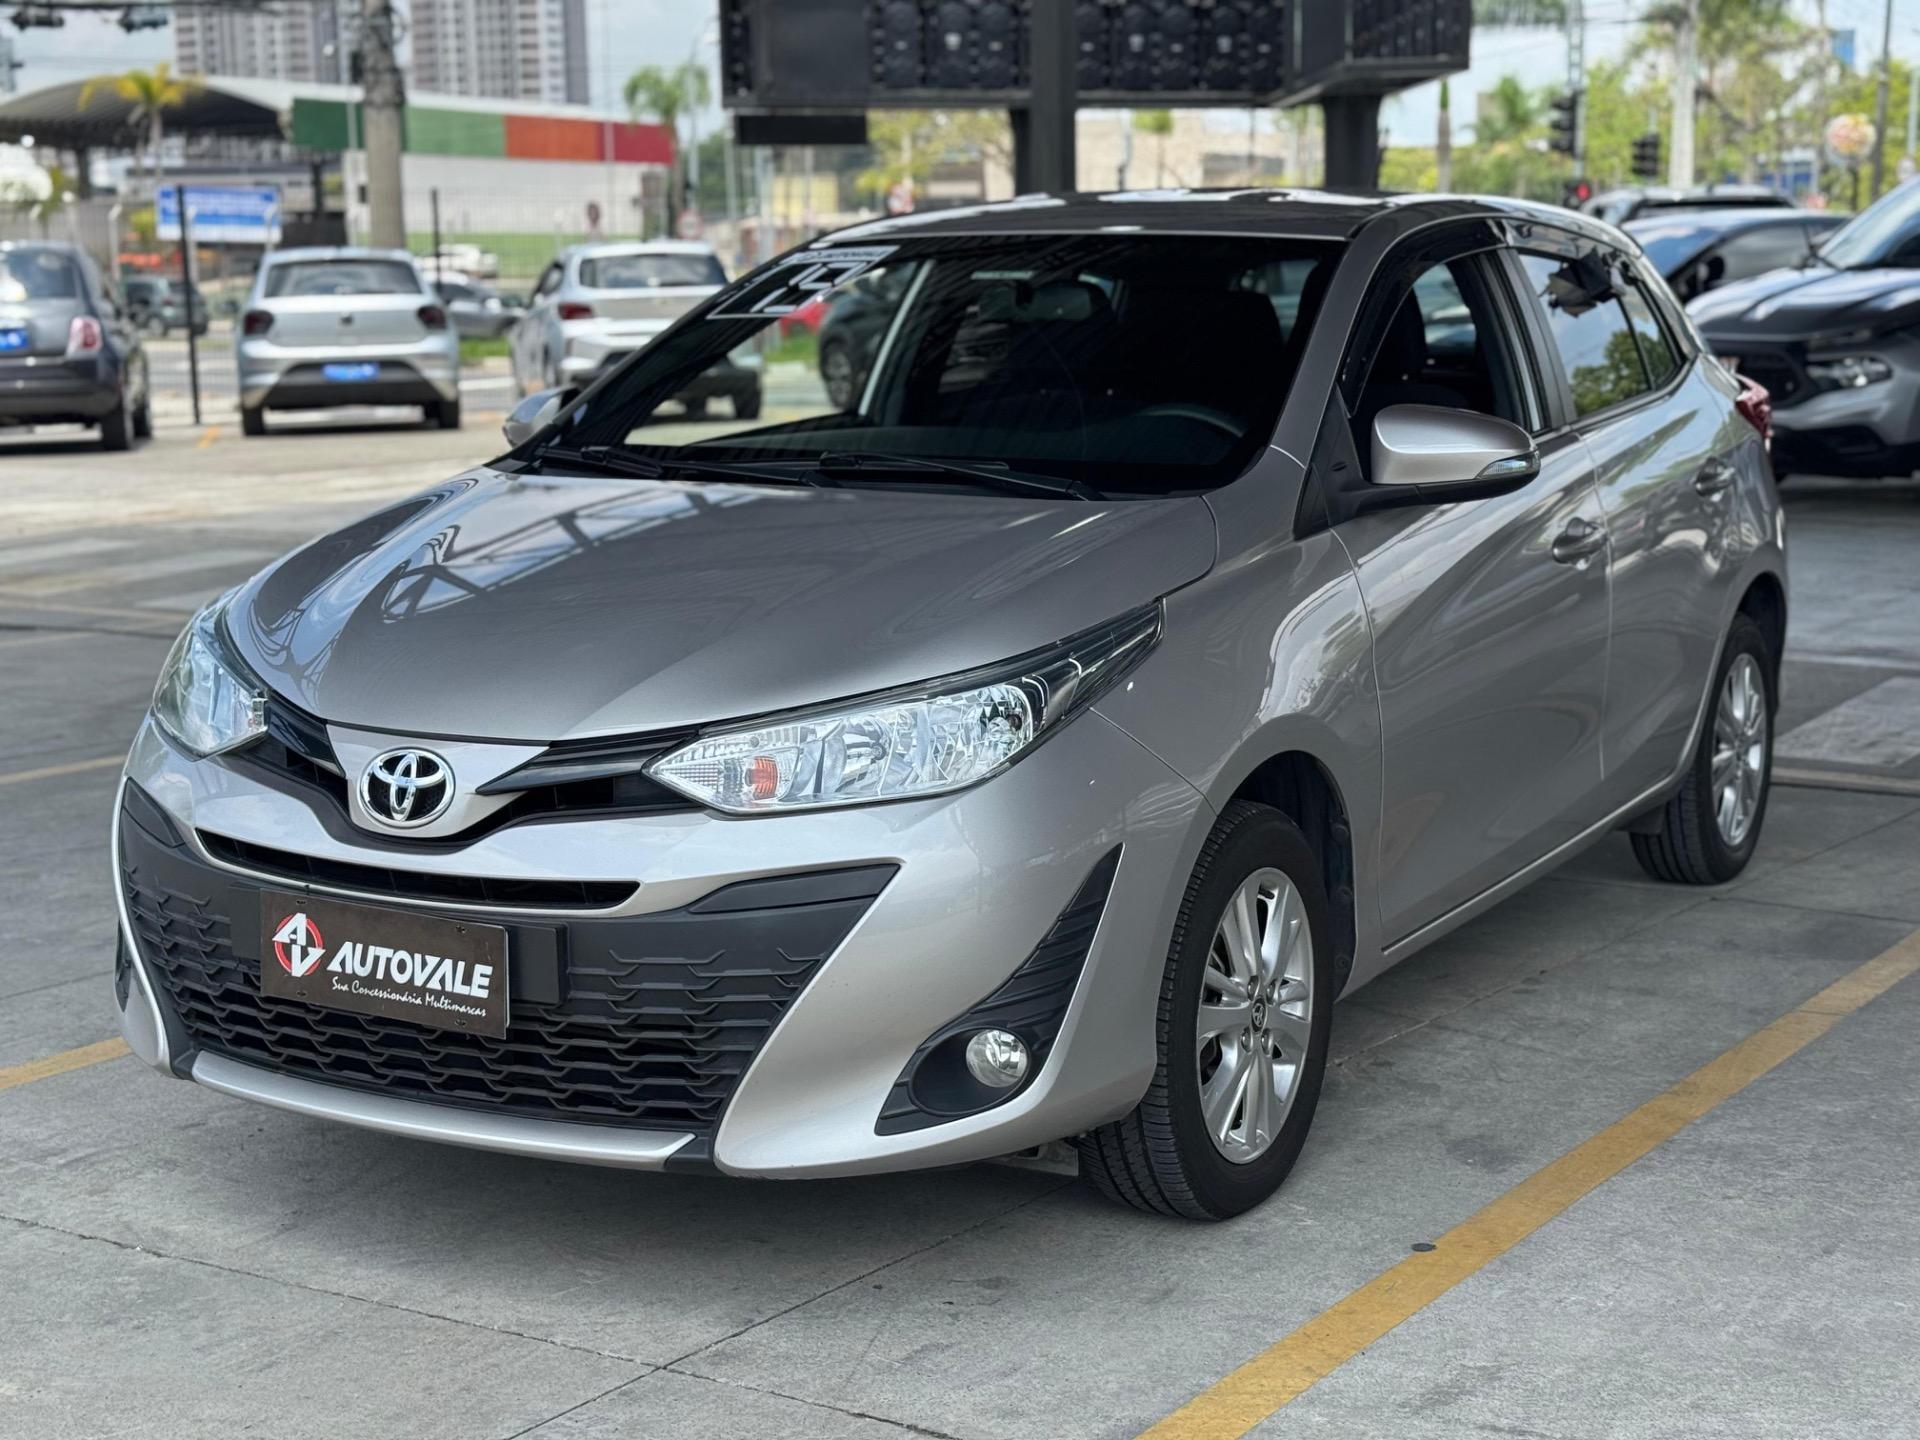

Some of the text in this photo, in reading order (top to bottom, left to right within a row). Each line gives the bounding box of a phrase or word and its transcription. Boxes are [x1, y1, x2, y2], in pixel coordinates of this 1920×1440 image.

[326, 941, 493, 999] AUTOVALE
[332, 976, 487, 1017] Sua Concessionária Multimarcas
